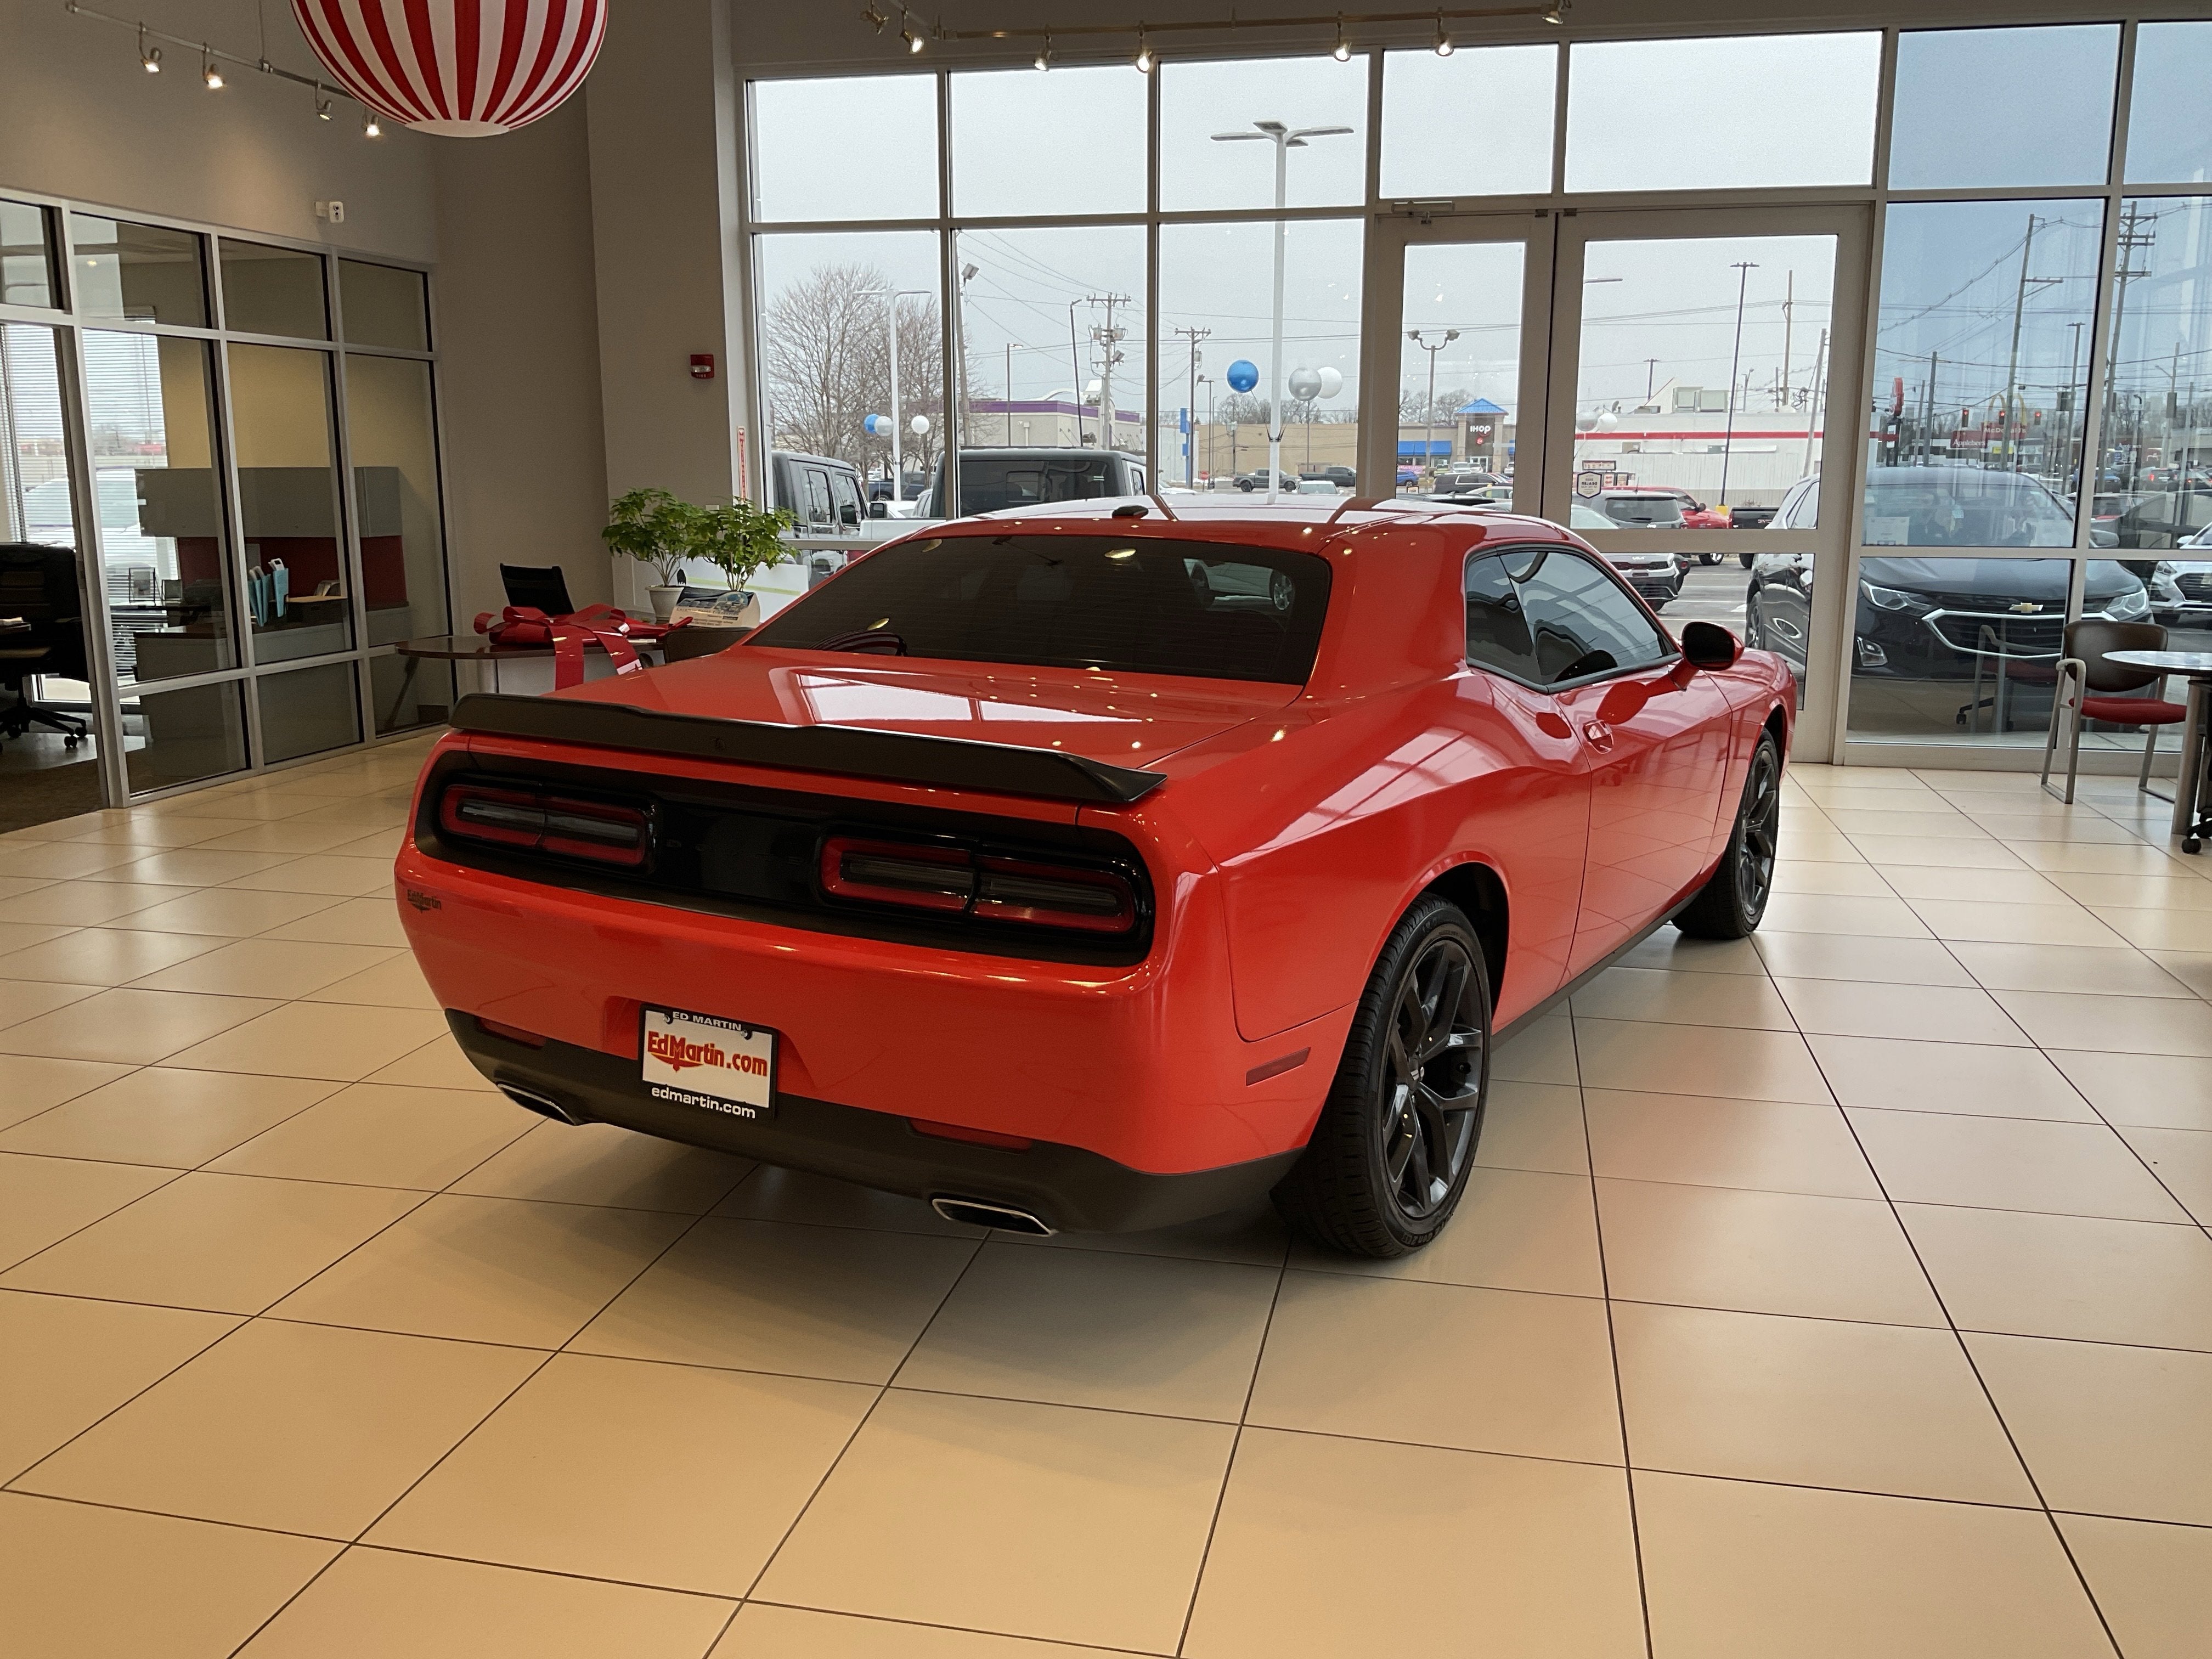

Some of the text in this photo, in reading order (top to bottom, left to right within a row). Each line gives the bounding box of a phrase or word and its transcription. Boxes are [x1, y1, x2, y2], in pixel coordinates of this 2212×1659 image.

[673, 1011, 742, 1031] ED MARTIN
[647, 1030, 768, 1077] EdMartin.com
[651, 1087, 755, 1119] edmartin.com
